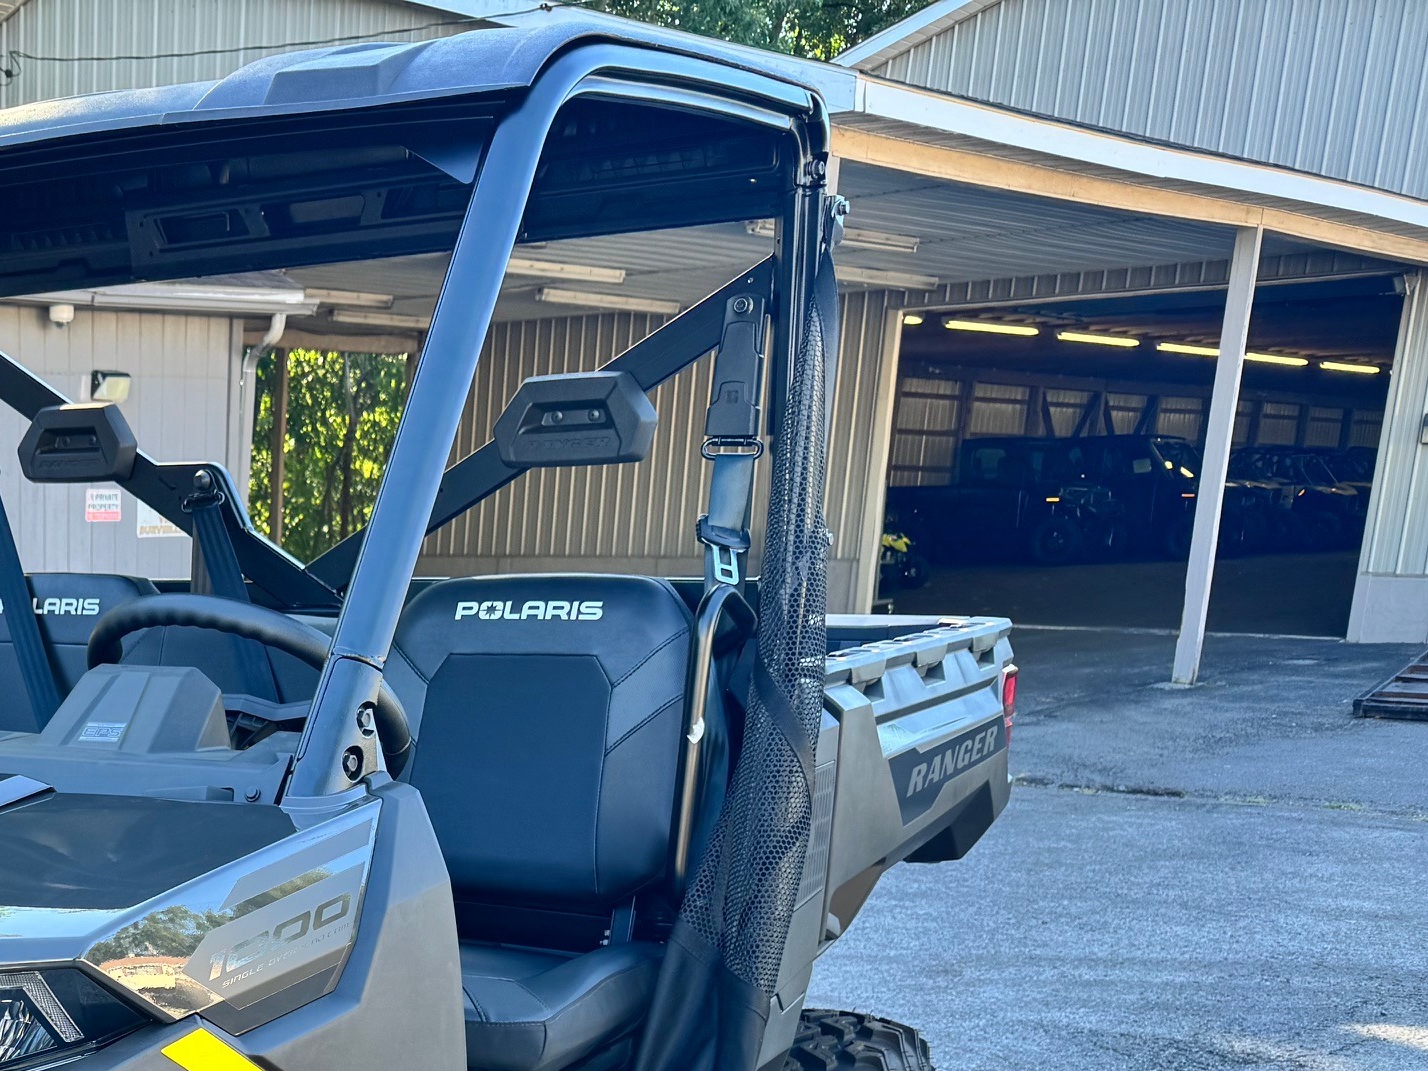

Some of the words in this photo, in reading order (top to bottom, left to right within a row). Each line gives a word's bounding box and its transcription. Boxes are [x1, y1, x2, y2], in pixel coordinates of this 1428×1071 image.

[454, 600, 604, 621] POLARIS
[82, 726, 125, 738] EPS
[905, 725, 999, 798] RANGER
[209, 893, 351, 981] 1000
[221, 963, 264, 988] SINGLE
